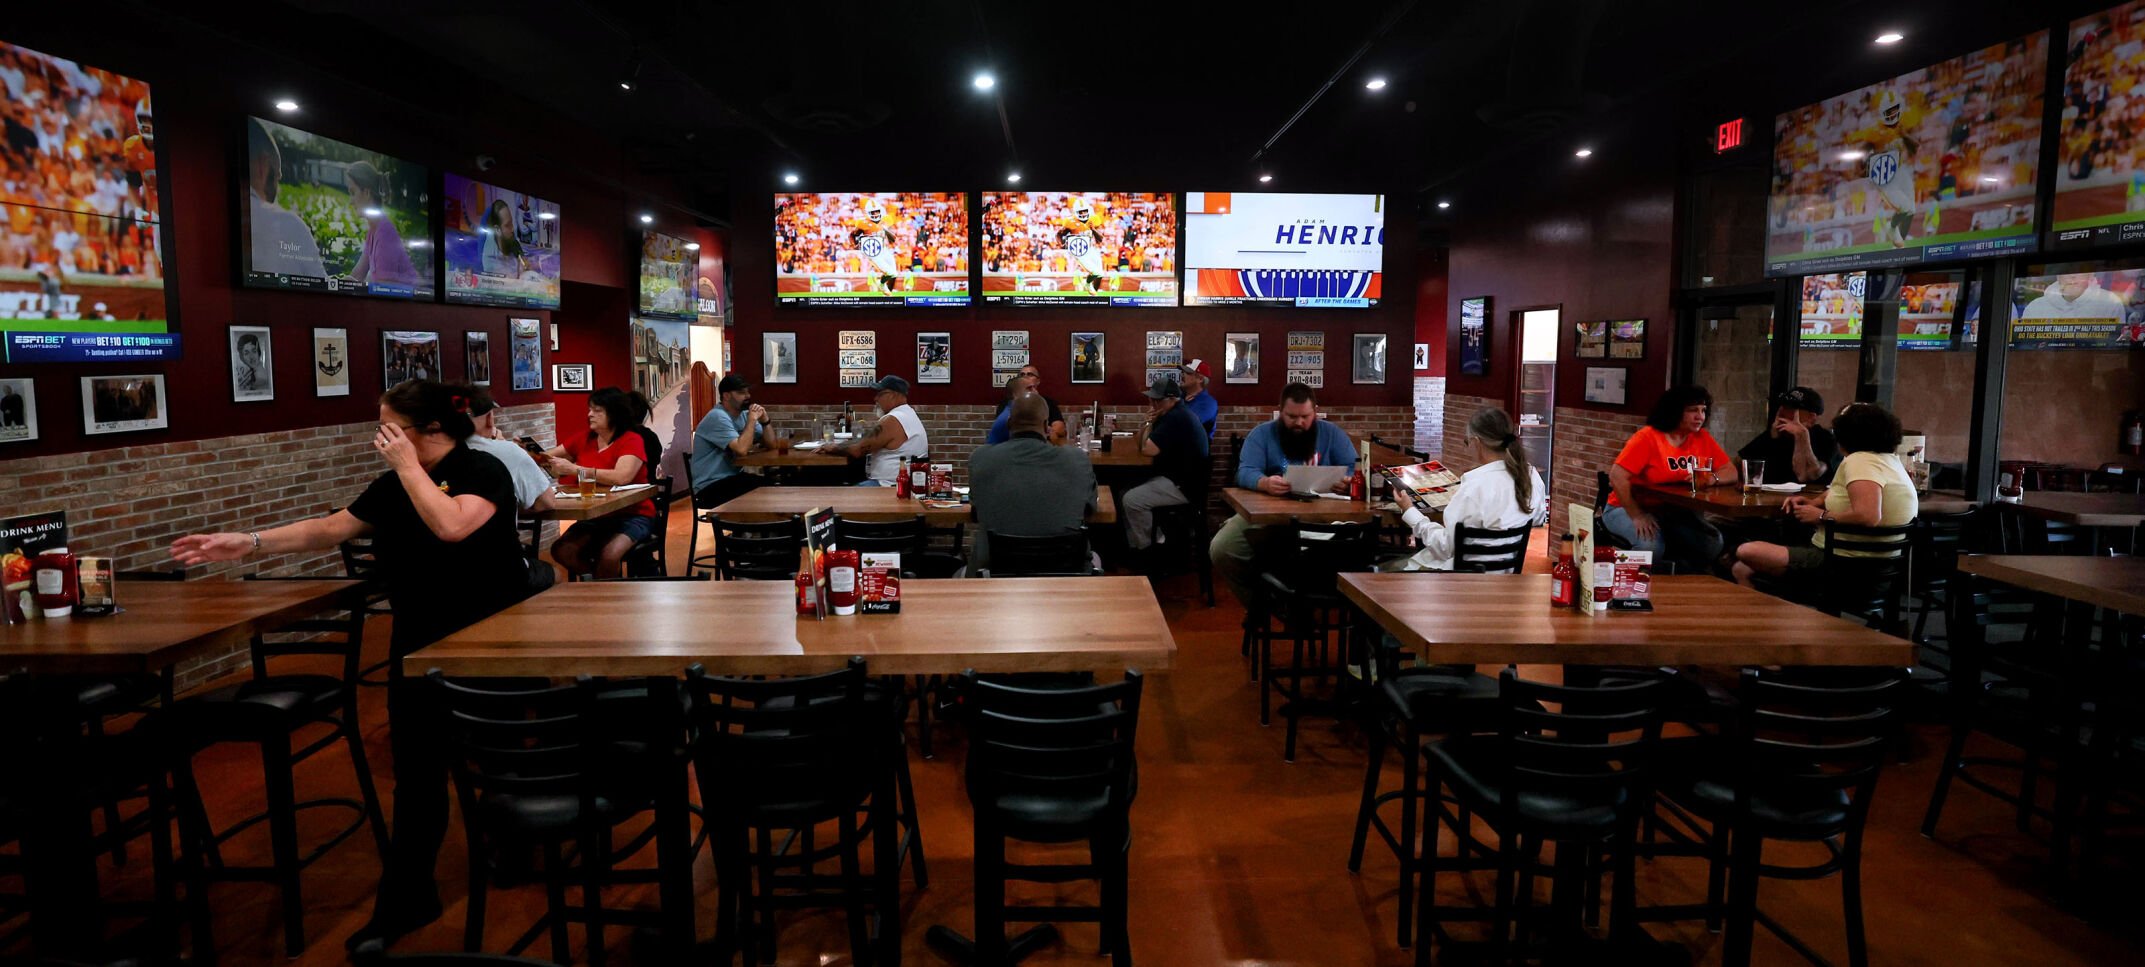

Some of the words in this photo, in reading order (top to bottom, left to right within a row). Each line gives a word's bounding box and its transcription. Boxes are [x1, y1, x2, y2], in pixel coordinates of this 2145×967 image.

[1718, 118, 1743, 151] EXIT
[1871, 155, 1897, 186] SEC
[2060, 230, 2090, 240] ESPN
[279, 240, 301, 252] Taylor
[863, 239, 882, 257] SEC
[1070, 238, 1089, 256] SEC
[15, 335, 45, 344] ESPN
[45, 335, 66, 344] BET
[96, 336, 110, 346] BET
[123, 336, 135, 346] GET
[841, 335, 873, 345] UFX-6586
[0, 526, 34, 538] DRINK
[36, 521, 63, 532] MENU
